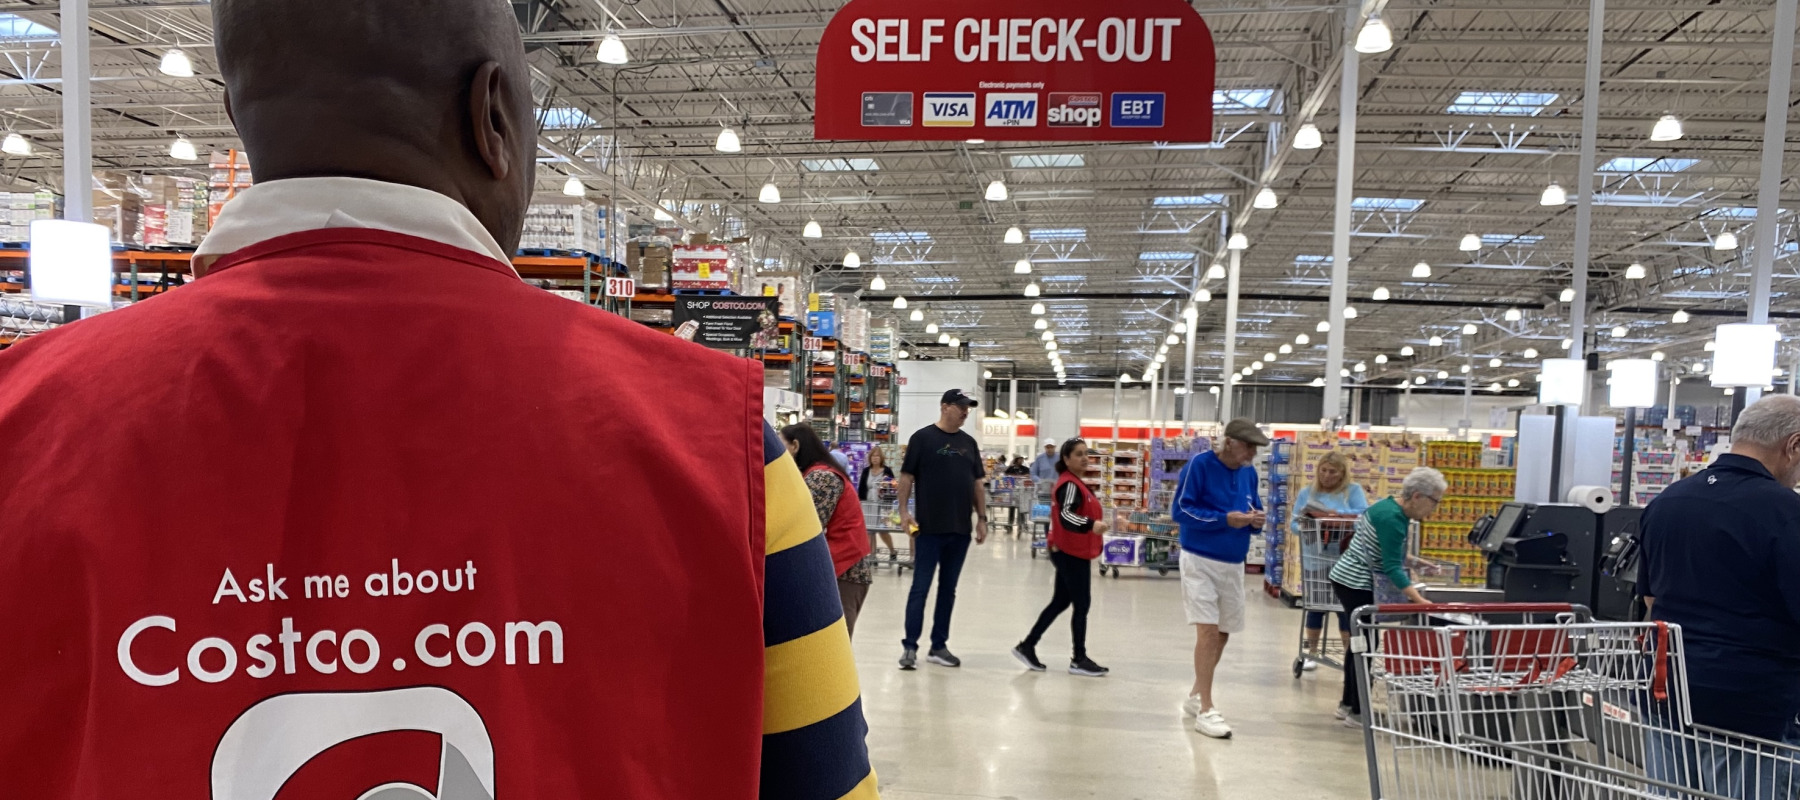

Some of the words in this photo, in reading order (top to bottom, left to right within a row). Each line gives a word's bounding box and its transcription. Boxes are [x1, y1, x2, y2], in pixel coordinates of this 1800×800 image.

[850, 17, 946, 63] SELF
[953, 17, 1182, 63] CHECK-OUT
[979, 81, 1005, 89] Electronic
[1005, 82, 1032, 90] payments
[1032, 81, 1045, 90] only
[930, 102, 969, 117] VISA
[987, 100, 1036, 119] ATM
[1121, 100, 1155, 115] EBT
[1048, 104, 1101, 127] shop
[609, 279, 633, 296] 310
[687, 301, 710, 309] SHOP
[712, 301, 766, 310] COSTCO.COM
[804, 337, 821, 349] 314
[844, 354, 859, 365] 316
[871, 366, 885, 376] 318
[985, 424, 1009, 435] DELI
[211, 562, 289, 605] Ask
[304, 572, 350, 599] me
[364, 557, 478, 597] about
[116, 614, 565, 687] Costco.com
